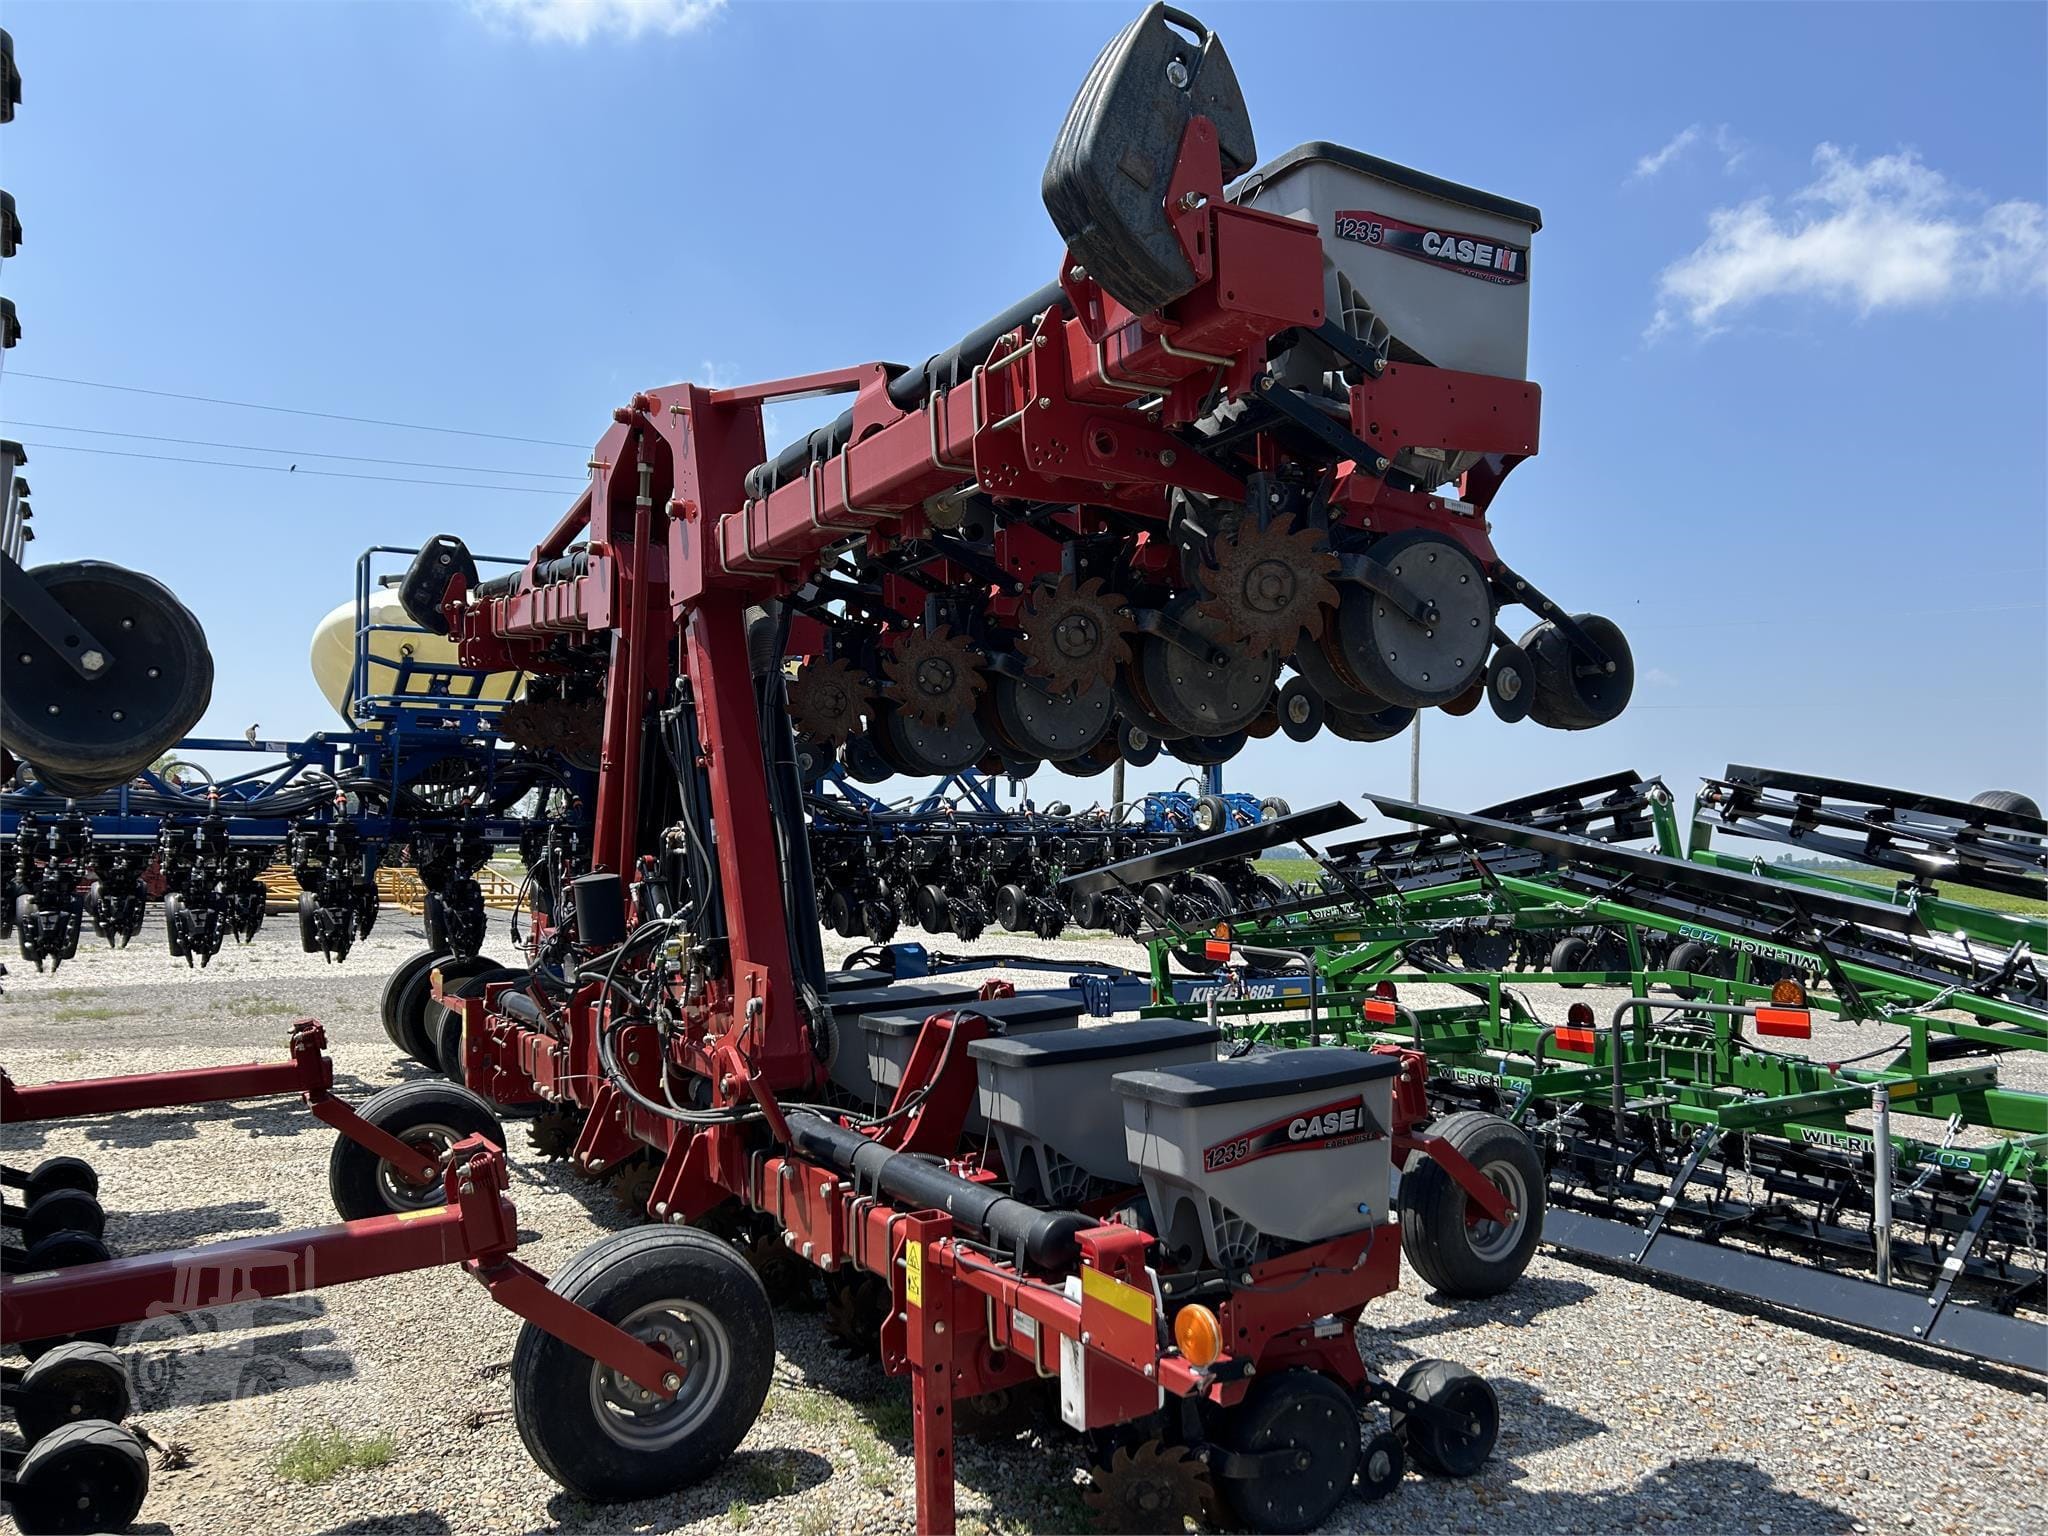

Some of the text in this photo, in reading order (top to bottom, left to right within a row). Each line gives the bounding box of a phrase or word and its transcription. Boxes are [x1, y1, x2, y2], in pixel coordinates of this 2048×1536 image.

[1336, 217, 1383, 244] 1235
[1422, 231, 1493, 267] CASE
[1678, 925, 1821, 972] WIL-RICH 1403
[1189, 984, 1275, 1002] KIZE 605
[1288, 1109, 1356, 1140] CASE
[1206, 1137, 1248, 1170] 1235
[1918, 1149, 1971, 1169] 1403
